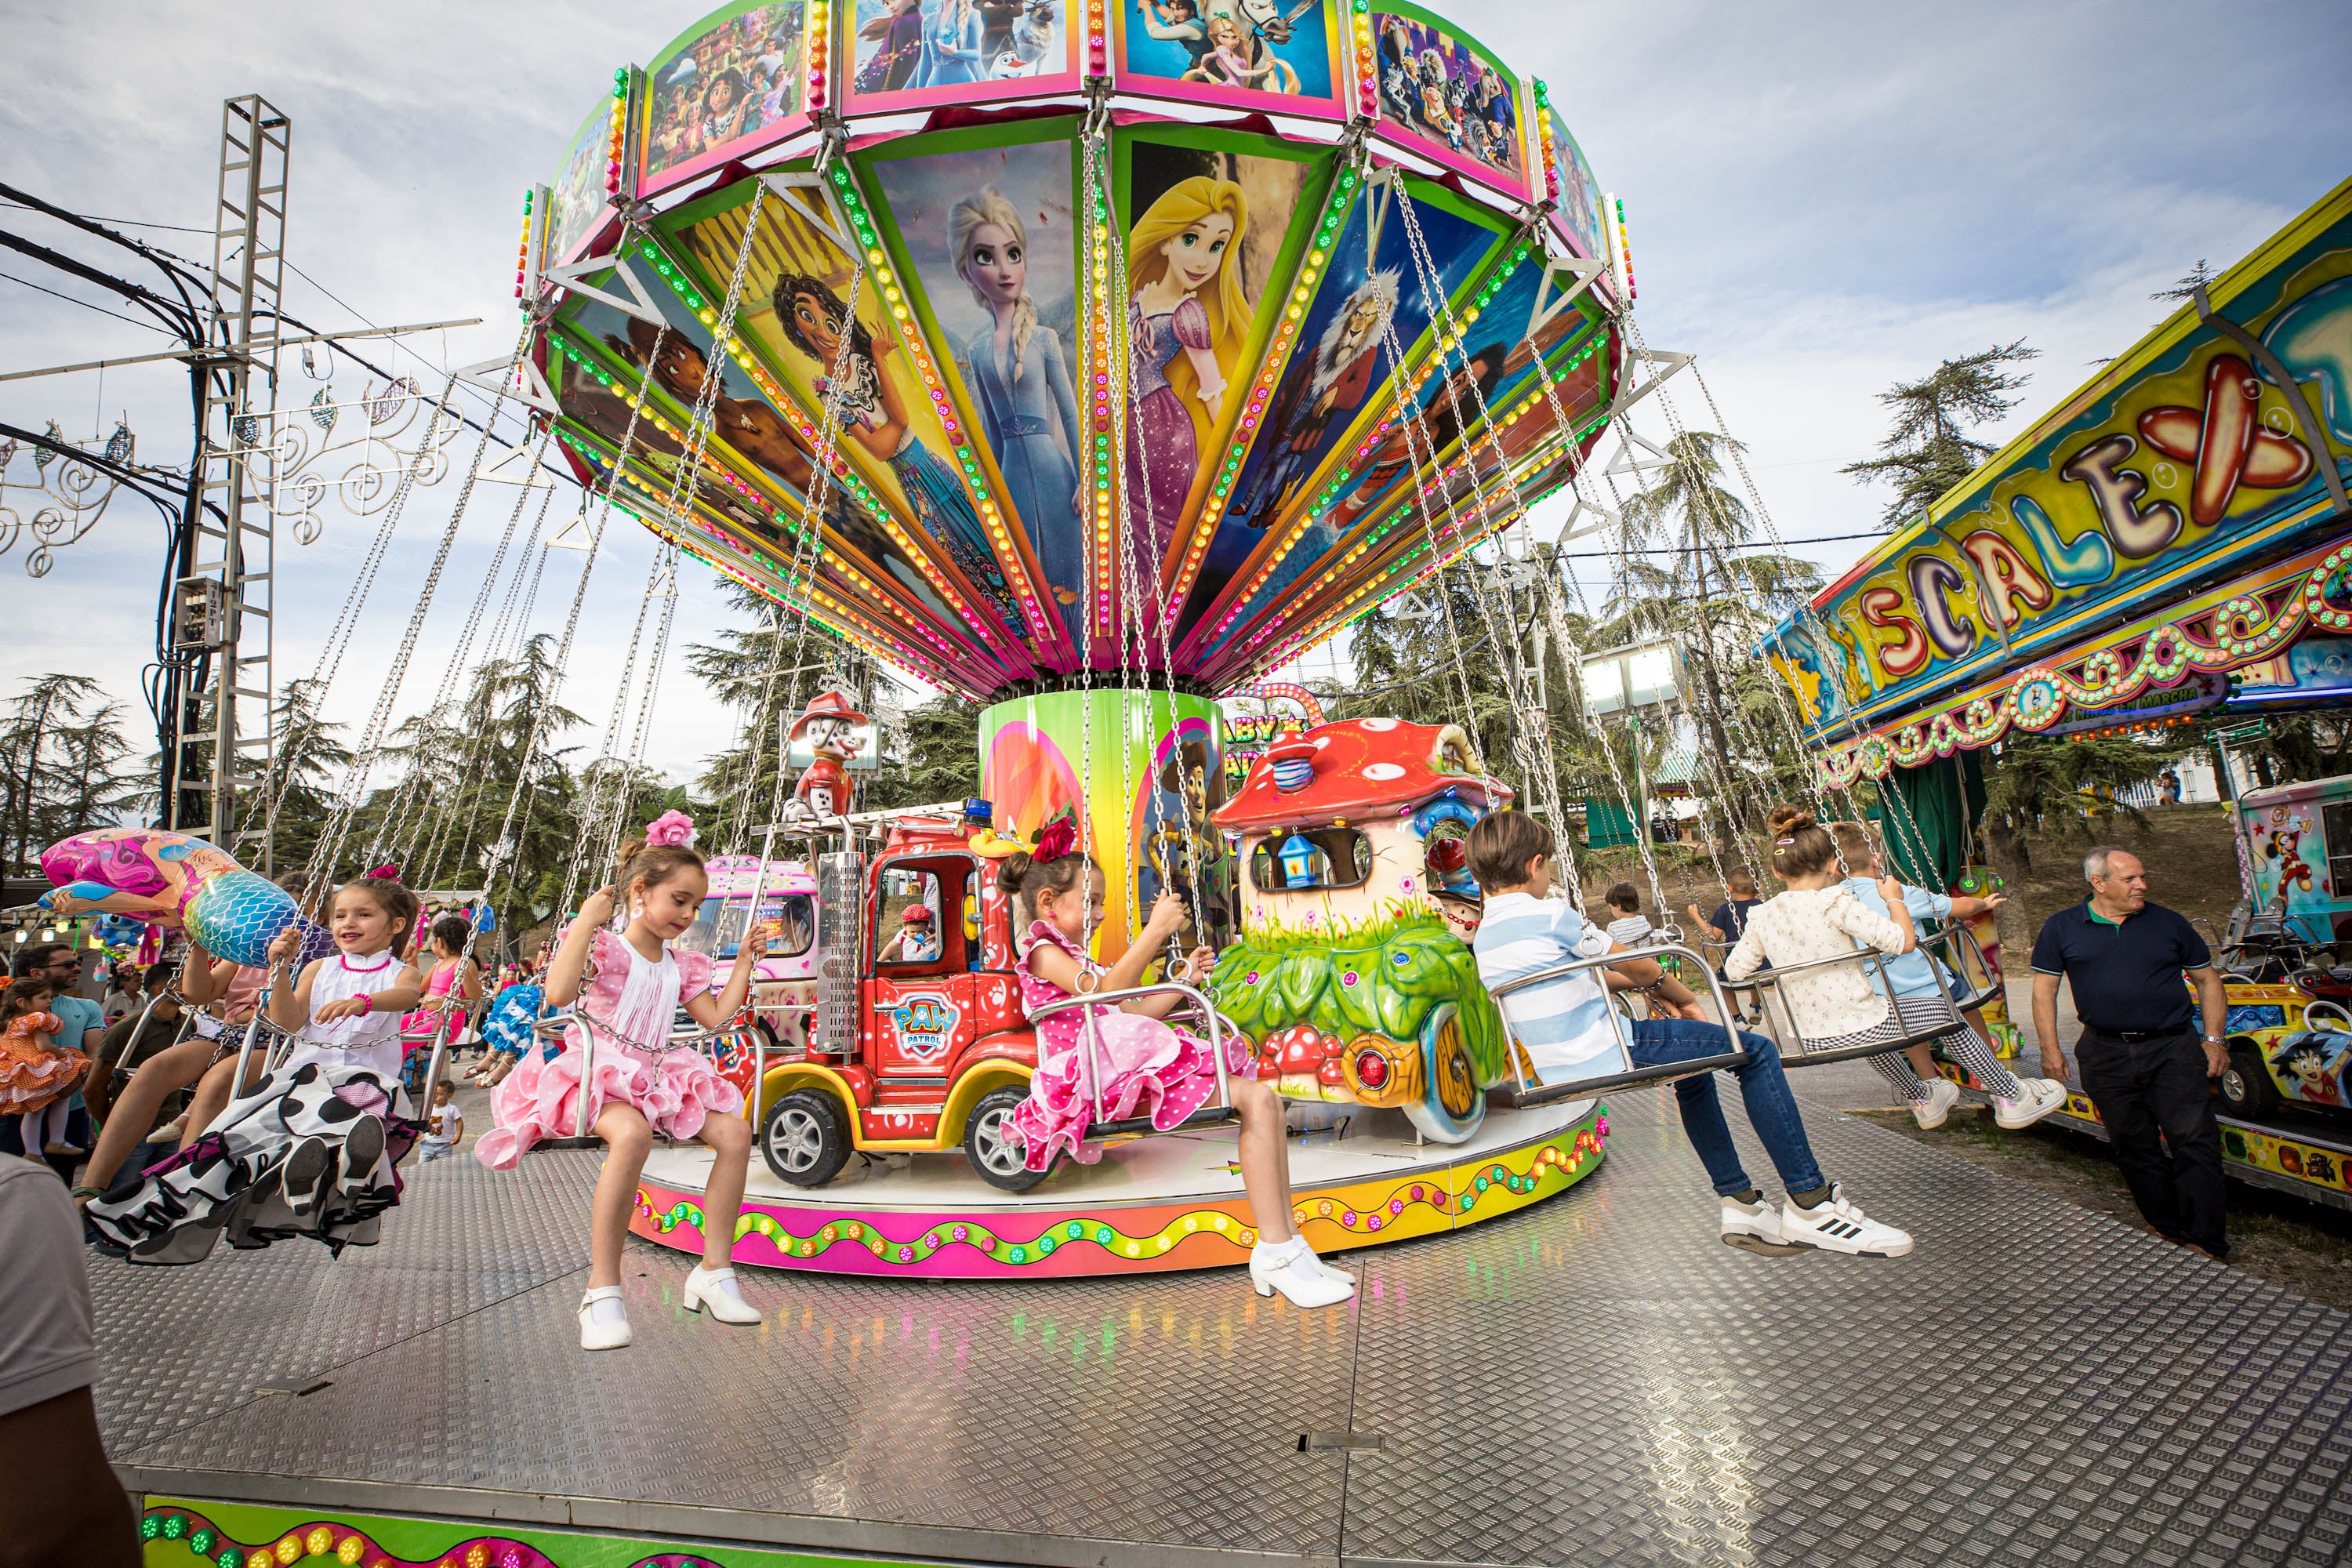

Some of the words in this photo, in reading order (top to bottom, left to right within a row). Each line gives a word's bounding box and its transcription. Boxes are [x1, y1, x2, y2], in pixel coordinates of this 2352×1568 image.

[2140, 687, 2197, 710] MARCHA
[893, 1004, 957, 1033] PAW
[907, 1035, 941, 1044] PATROL
